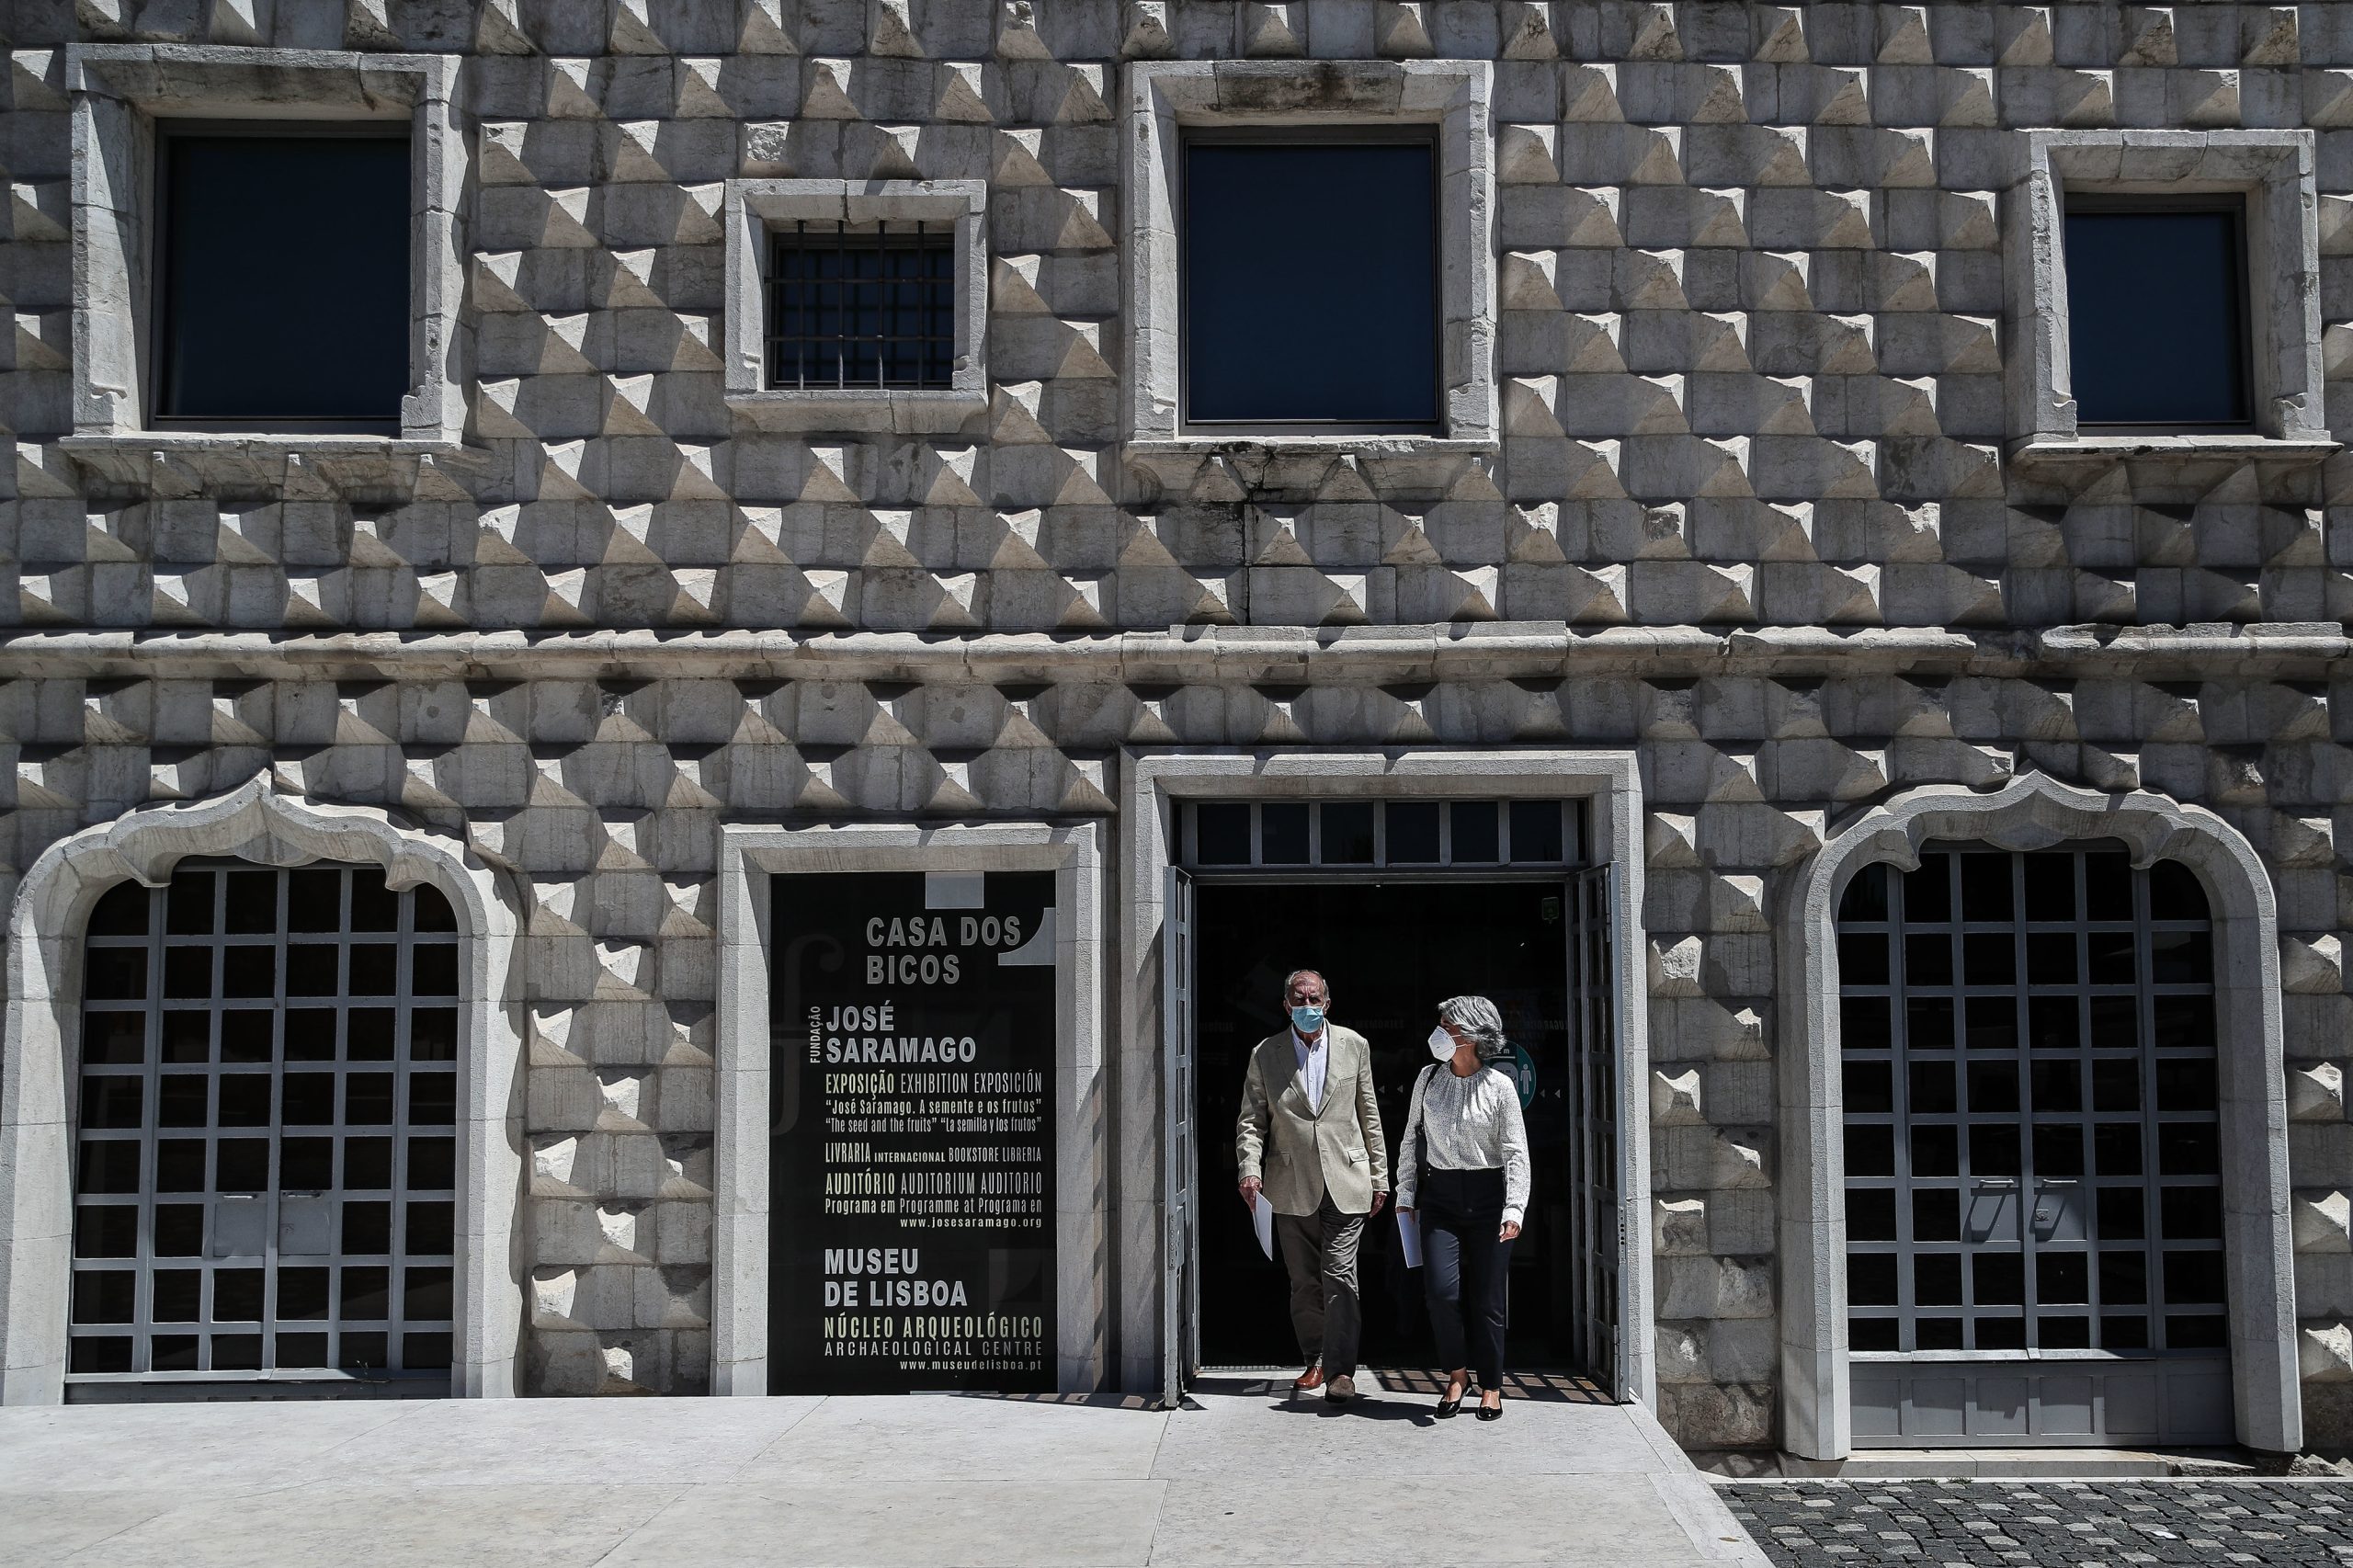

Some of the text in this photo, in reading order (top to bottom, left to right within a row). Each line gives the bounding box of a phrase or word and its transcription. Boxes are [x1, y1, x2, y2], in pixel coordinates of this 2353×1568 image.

[867, 916, 1021, 947] CASA DOS
[868, 955, 960, 984] BICOS
[826, 1000, 893, 1031] JOSÉ
[809, 1006, 823, 1062] FUNDAÇÃO
[826, 1037, 975, 1063] SARAMAGO
[825, 1069, 1041, 1100] EXPOSIÇÃO EXHIBITION EXPOSICIÓN
[859, 1099, 915, 1117] Saramago.
[919, 1099, 926, 1115] A
[928, 1099, 974, 1115] semente
[977, 1101, 983, 1114] e
[986, 1101, 999, 1114] os
[847, 1118, 869, 1133] seed
[870, 1118, 887, 1133] and
[890, 1118, 904, 1133] the
[957, 1117, 987, 1132] semilla
[989, 1119, 995, 1134] y
[995, 1117, 1009, 1132] los
[826, 1142, 1041, 1163] LIVRARIA INTERNACIONAL BOOKSTORE LIBRERIA
[825, 1168, 1041, 1194] AUDITÓRIO AUDITORIUM AUDITORIO
[824, 1198, 1042, 1216] Programa em Programme at Programa en
[900, 1217, 1041, 1229] www.josesaramago.org
[825, 1248, 917, 1274] MUSEU
[825, 1280, 967, 1306] DE LISBOA
[824, 1312, 1041, 1340] NÚCLEO ARQUEOLÓGICO
[824, 1341, 1042, 1357] ARCHAEOLOGICAL CENTRE
[899, 1359, 1041, 1371] www.museudelisboa.pt
